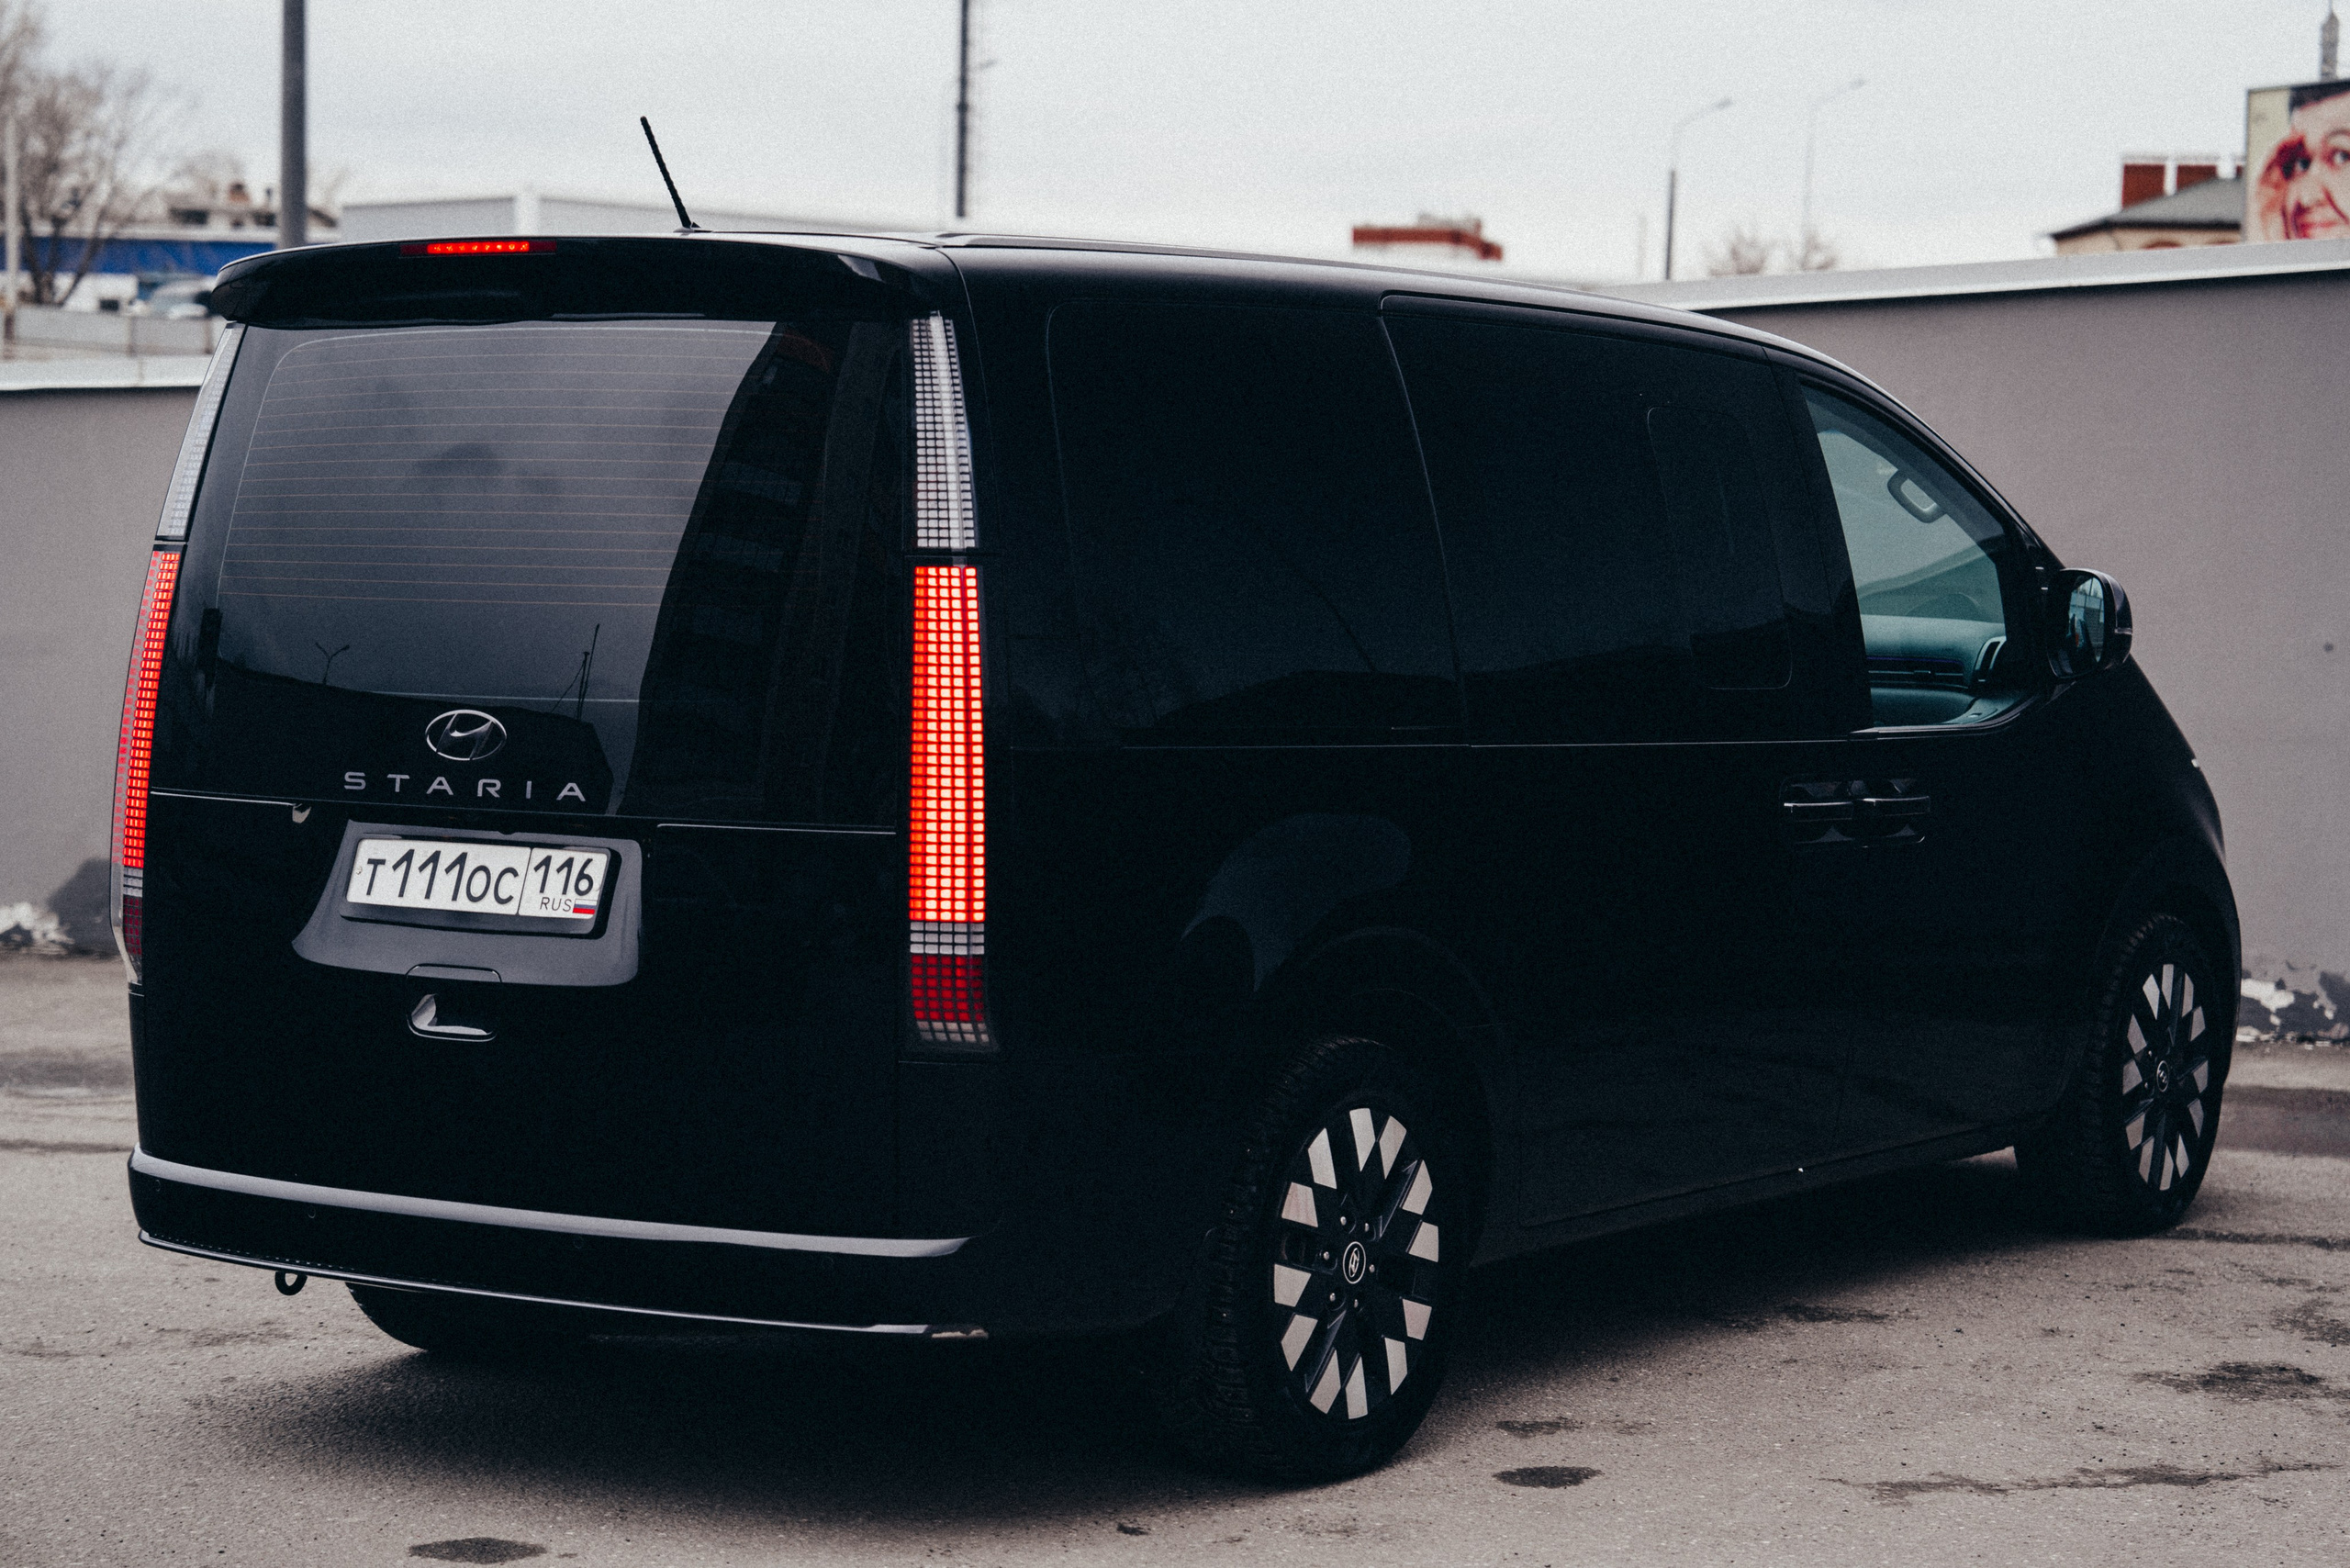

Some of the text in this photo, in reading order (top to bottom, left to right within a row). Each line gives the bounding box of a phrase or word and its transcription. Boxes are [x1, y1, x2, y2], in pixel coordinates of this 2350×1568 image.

[343, 771, 587, 802] STARIA
[533, 855, 594, 897] 116
[540, 897, 572, 913] RUS
